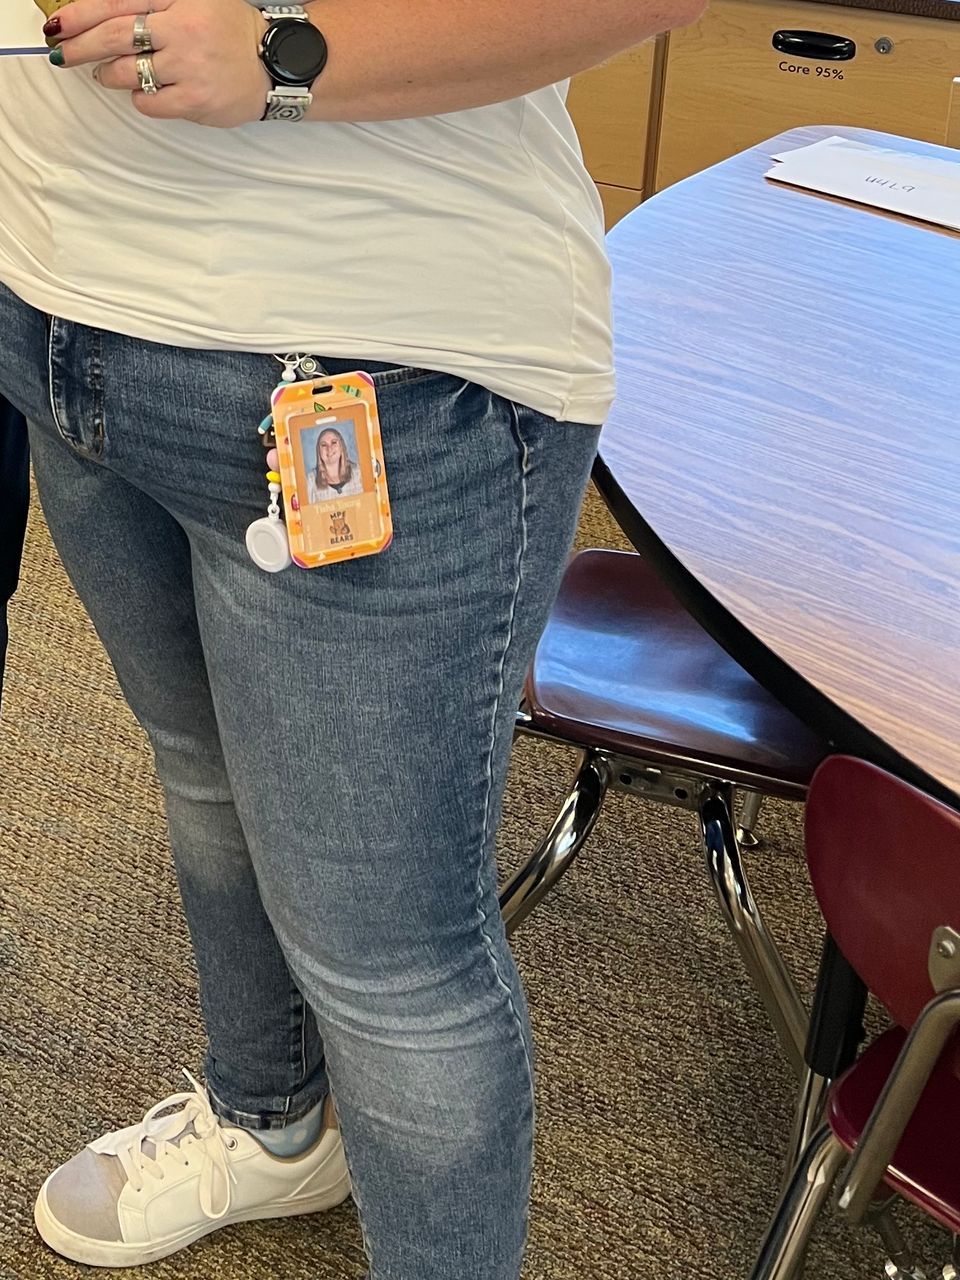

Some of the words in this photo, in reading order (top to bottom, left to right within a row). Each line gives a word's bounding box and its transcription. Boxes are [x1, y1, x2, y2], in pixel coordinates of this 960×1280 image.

[778, 61, 810, 75] Core
[815, 66, 844, 80] 95%
[330, 534, 354, 545] BEARS
